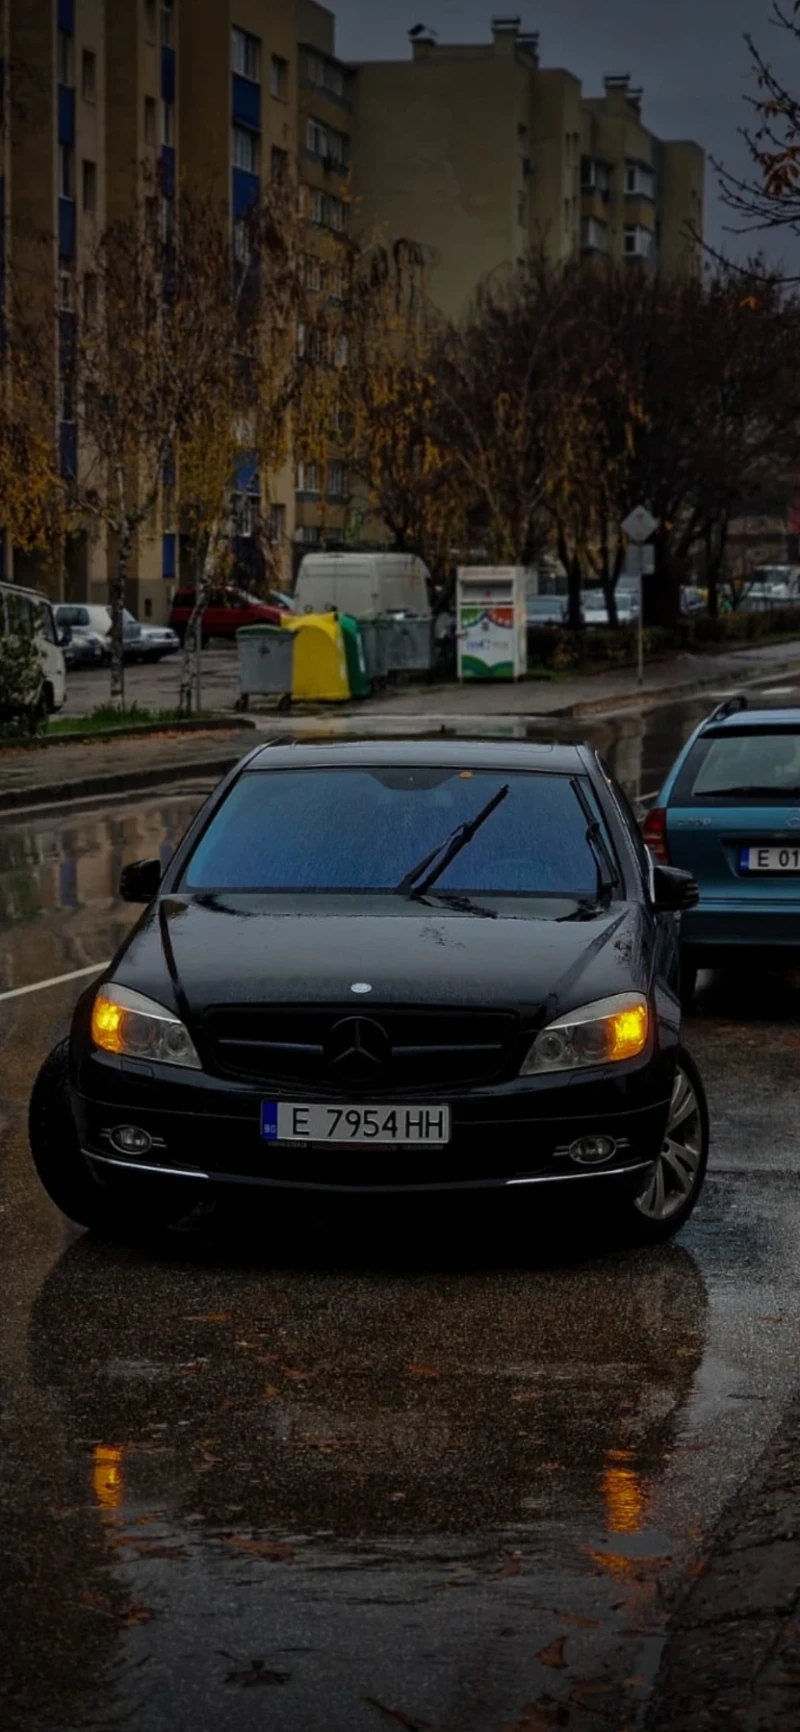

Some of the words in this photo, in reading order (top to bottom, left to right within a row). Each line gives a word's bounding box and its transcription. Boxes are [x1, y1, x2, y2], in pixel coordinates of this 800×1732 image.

[757, 849, 769, 867] E
[263, 1123, 277, 1134] BG
[292, 1107, 310, 1136] E
[326, 1108, 398, 1138] 7954
[405, 1110, 443, 1139] HH
